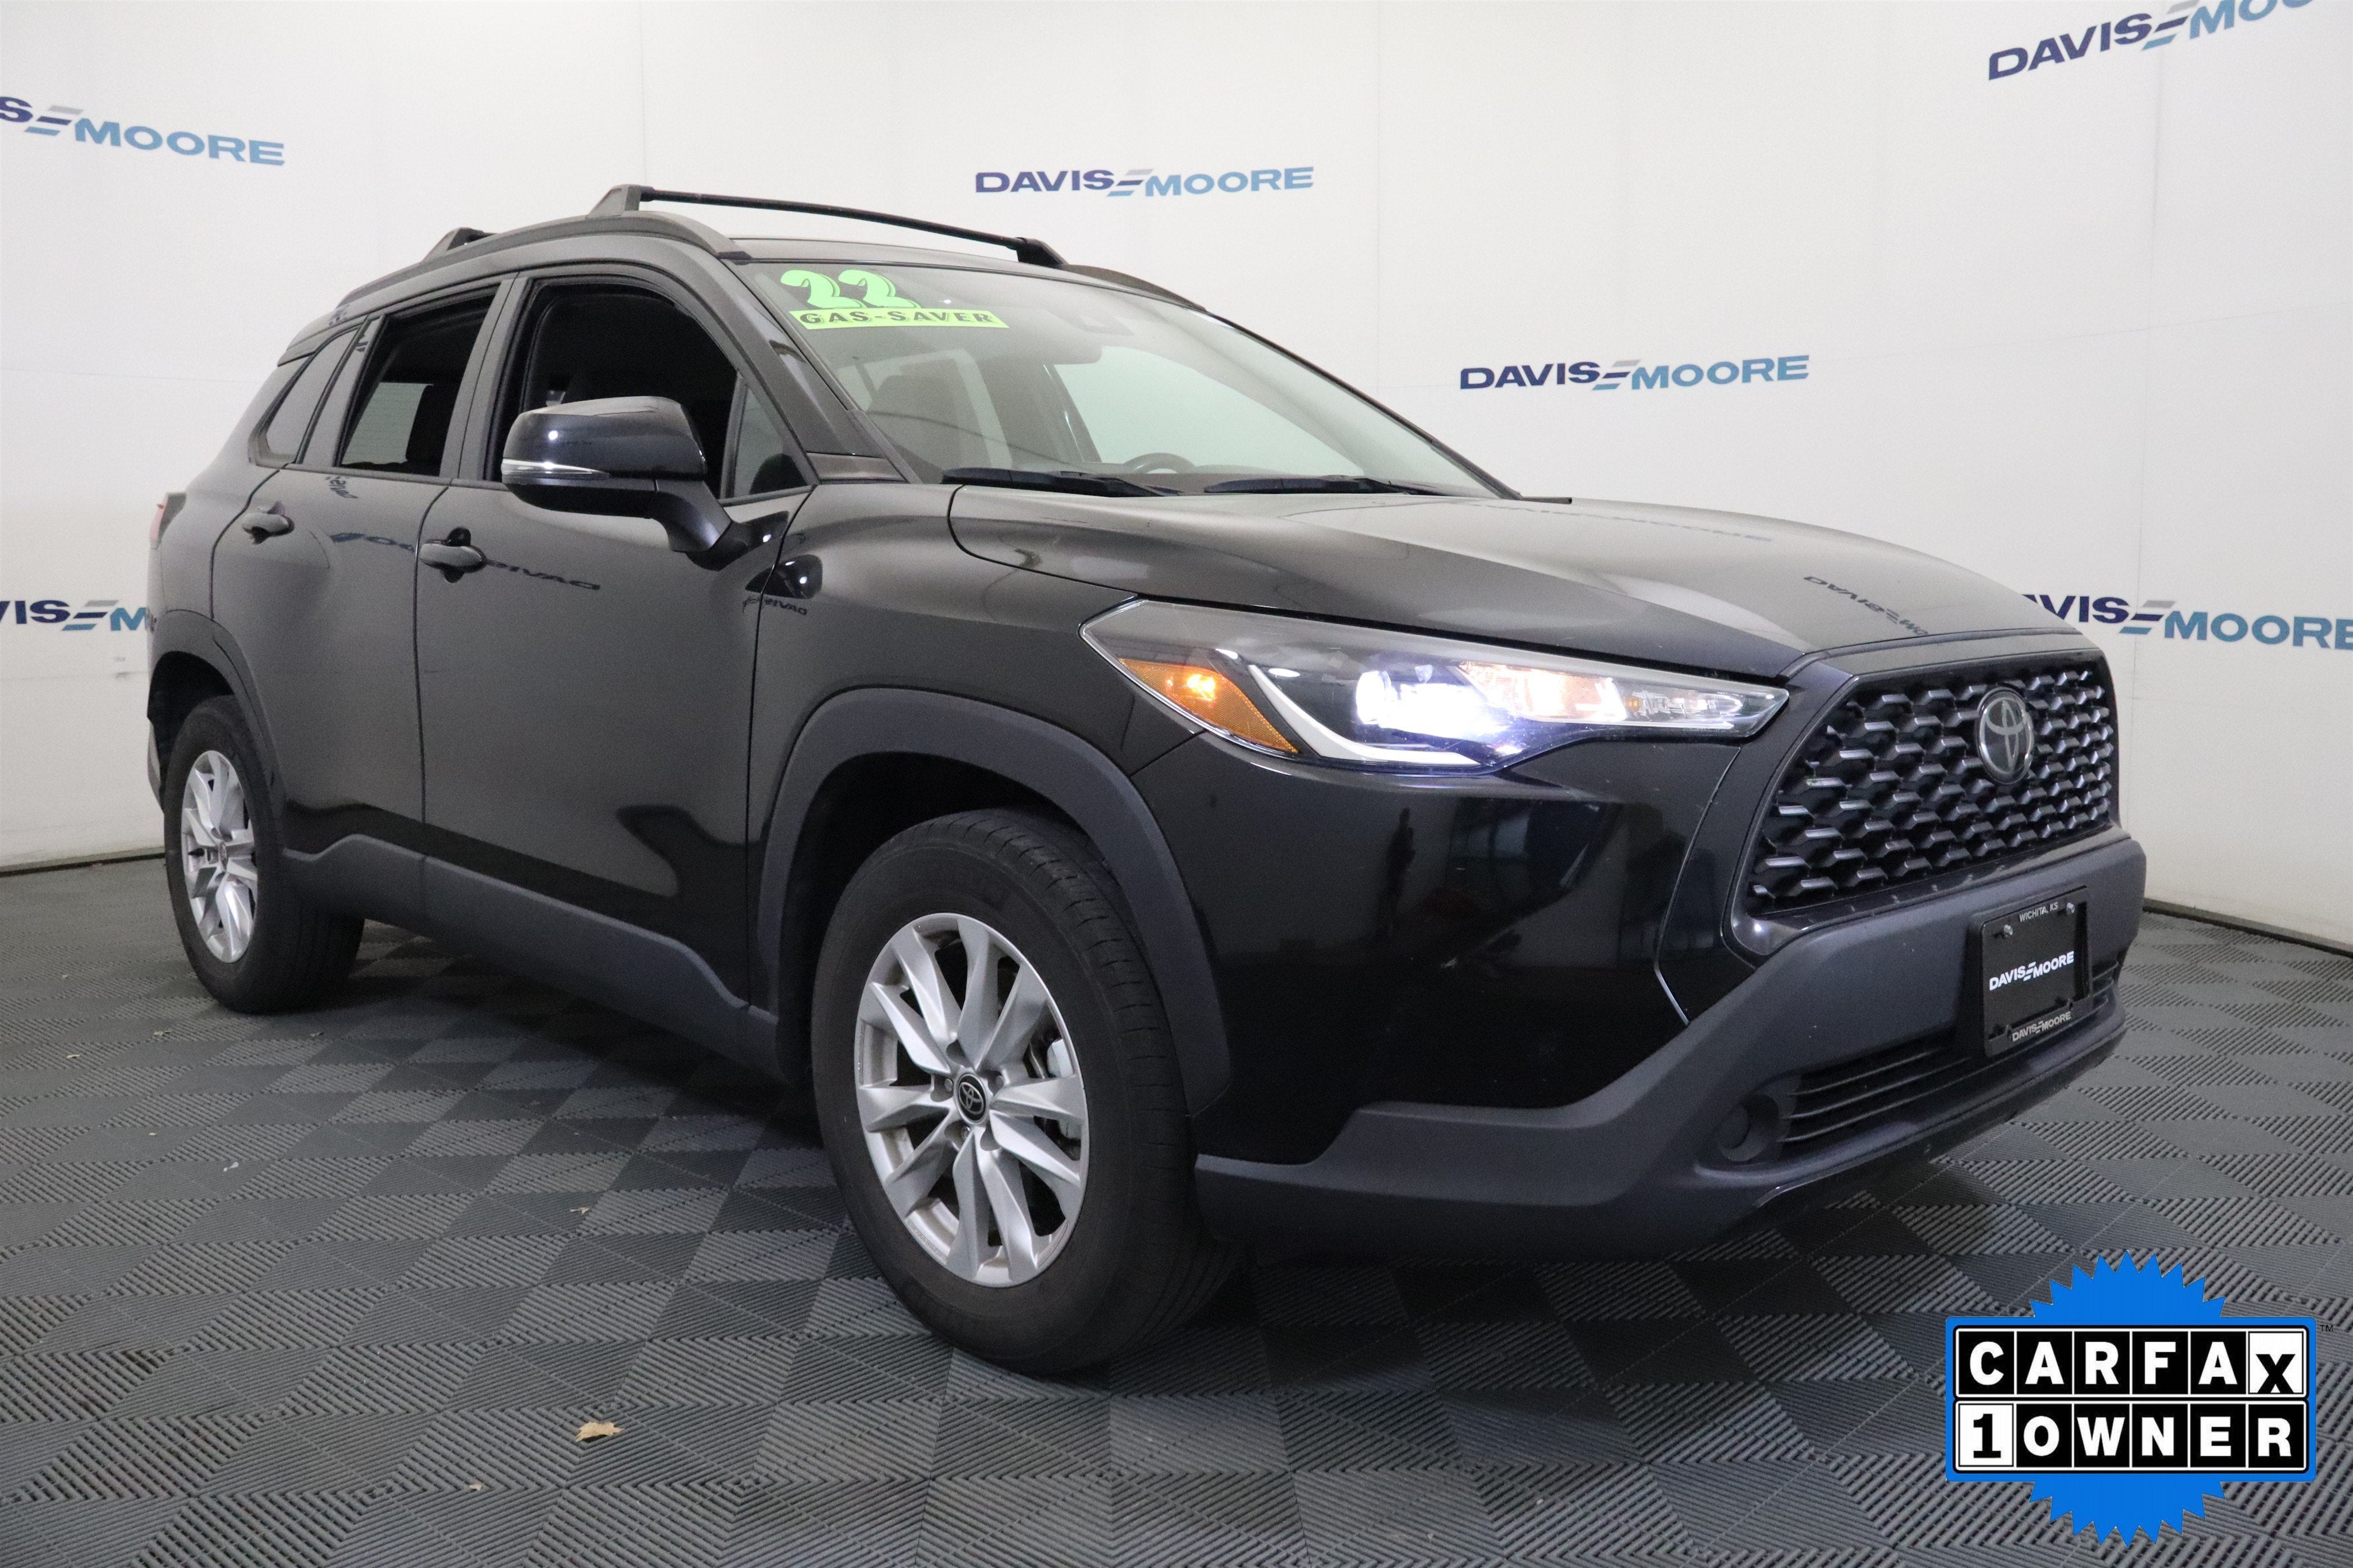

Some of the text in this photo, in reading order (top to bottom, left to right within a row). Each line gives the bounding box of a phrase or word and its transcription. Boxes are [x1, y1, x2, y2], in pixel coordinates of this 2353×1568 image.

[1989, 13, 2152, 81] DAVIS
[75, 118, 285, 166] MOORE
[975, 166, 1314, 197] DAVIS MOORE
[781, 269, 921, 308] 22
[800, 311, 994, 325] GAS-SAVER
[1460, 355, 1810, 391] DAVIS MOORE
[2019, 901, 2058, 922] WICHITA, KS
[1989, 951, 2074, 991] DAVIS MOORE
[2012, 1011, 2072, 1042] DAVIS MOORE
